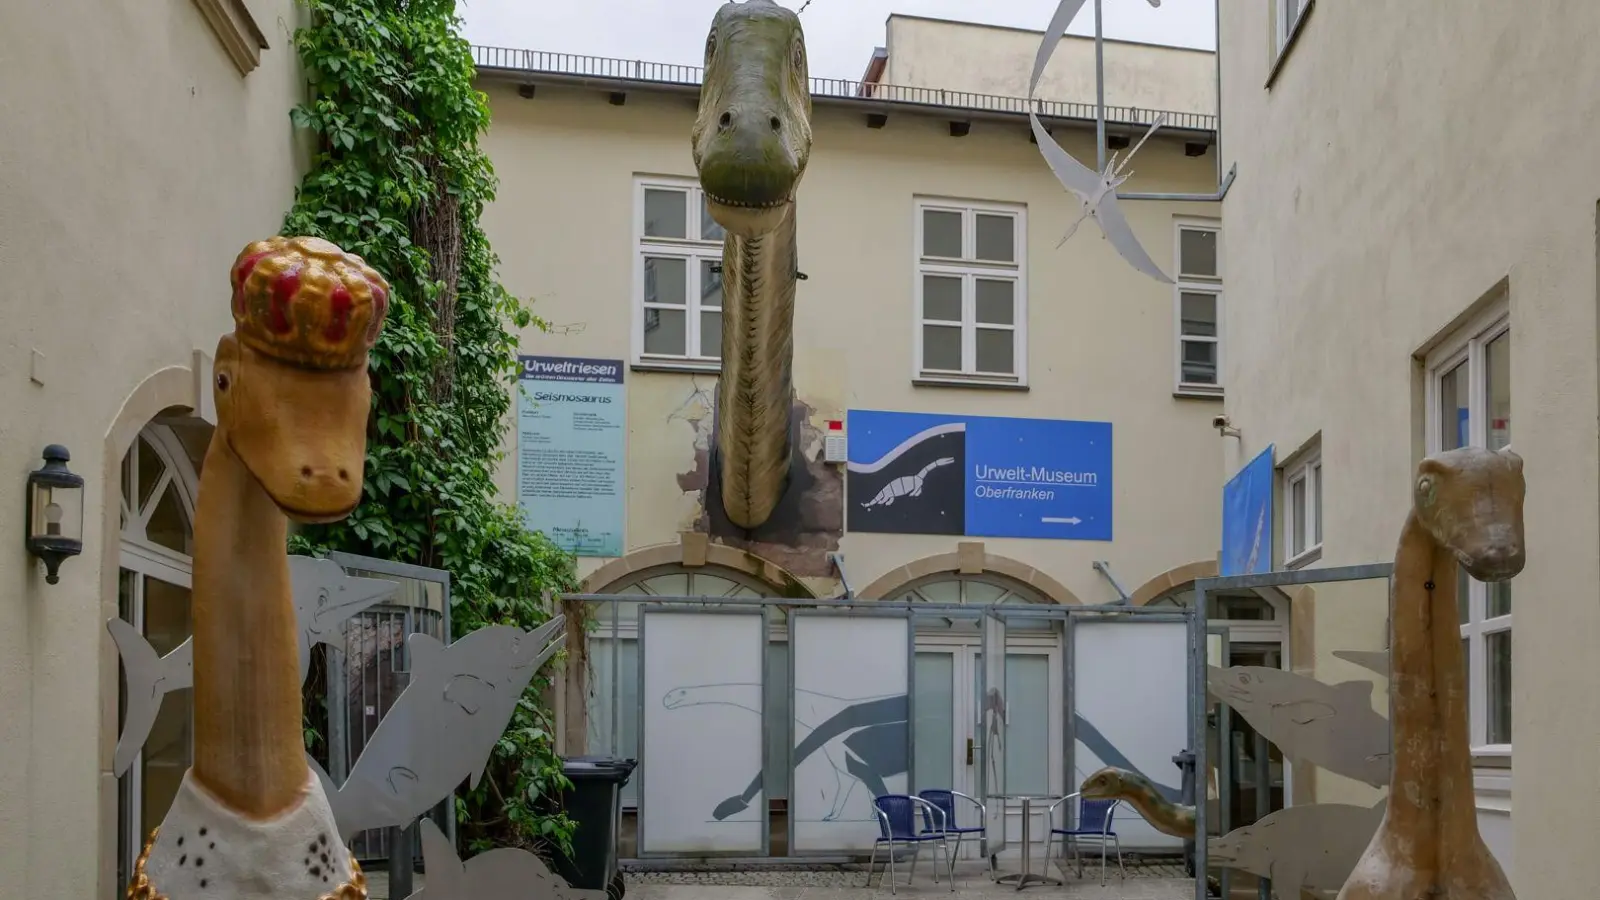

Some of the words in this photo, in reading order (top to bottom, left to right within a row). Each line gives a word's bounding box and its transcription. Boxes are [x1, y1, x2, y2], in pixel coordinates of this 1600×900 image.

[525, 360, 616, 375] Urweltriesen
[534, 392, 612, 404] Seismosaurus
[975, 464, 1097, 484] Urwelt-Museum
[975, 485, 1055, 500] Oberfranken
